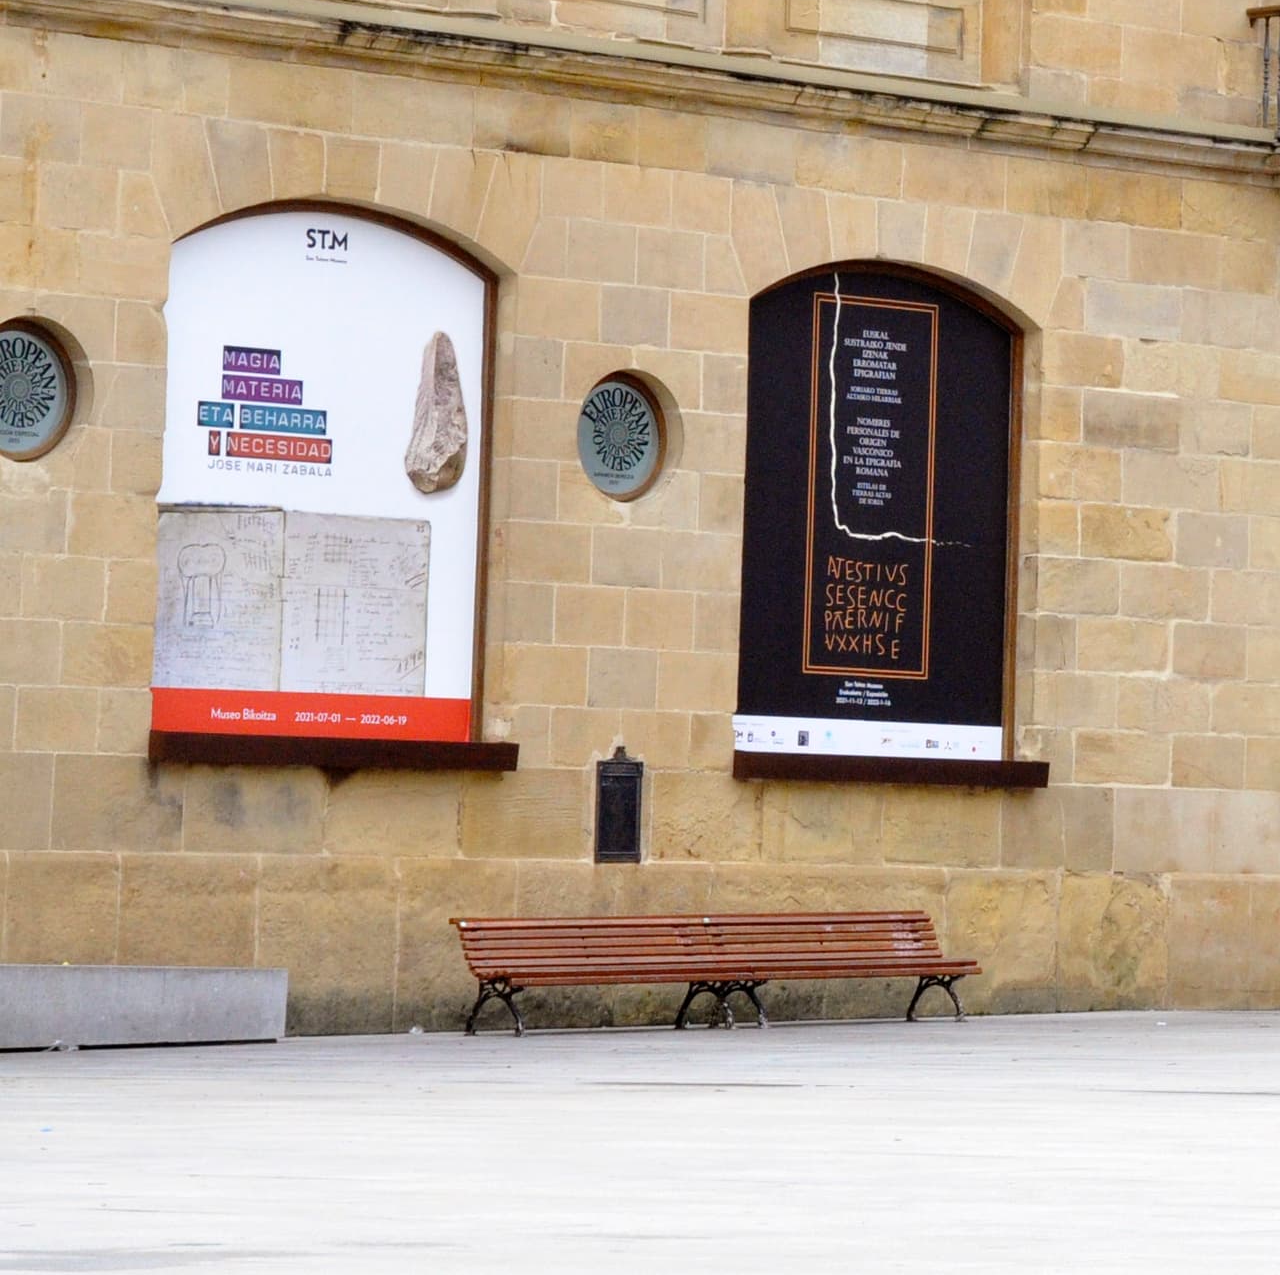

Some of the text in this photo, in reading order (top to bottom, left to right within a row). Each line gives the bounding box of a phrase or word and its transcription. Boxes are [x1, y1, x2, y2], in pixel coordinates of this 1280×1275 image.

[306, 228, 348, 252] STM
[862, 329, 889, 340] EUSKAL
[844, 338, 908, 352] SUSTRAIKO JENDE
[223, 350, 280, 370] MAGIA
[862, 349, 889, 360] IZENAK
[852, 358, 898, 370] ERROMATAR
[853, 368, 897, 380] EPIGRAFIAN
[222, 379, 302, 400] MATERIA
[199, 405, 326, 430] ETA BEHARRA
[581, 387, 650, 436] EUROPEAN
[856, 417, 891, 427] NOMBRES
[846, 426, 901, 439] PERSONALES DE
[210, 435, 332, 458] Y NECESIDAD
[858, 437, 887, 447] ORIGEN
[596, 434, 650, 472] MUSEUM
[843, 456, 854, 465] EN
[854, 457, 865, 465] LA
[208, 459, 332, 477] JOSE MARI ZABALA
[856, 467, 889, 477] ROMANA
[210, 708, 241, 720] Museo
[243, 708, 277, 721] Bikoitza
[295, 711, 341, 723] 2021-07-01
[360, 713, 408, 725] 2022-06-19
